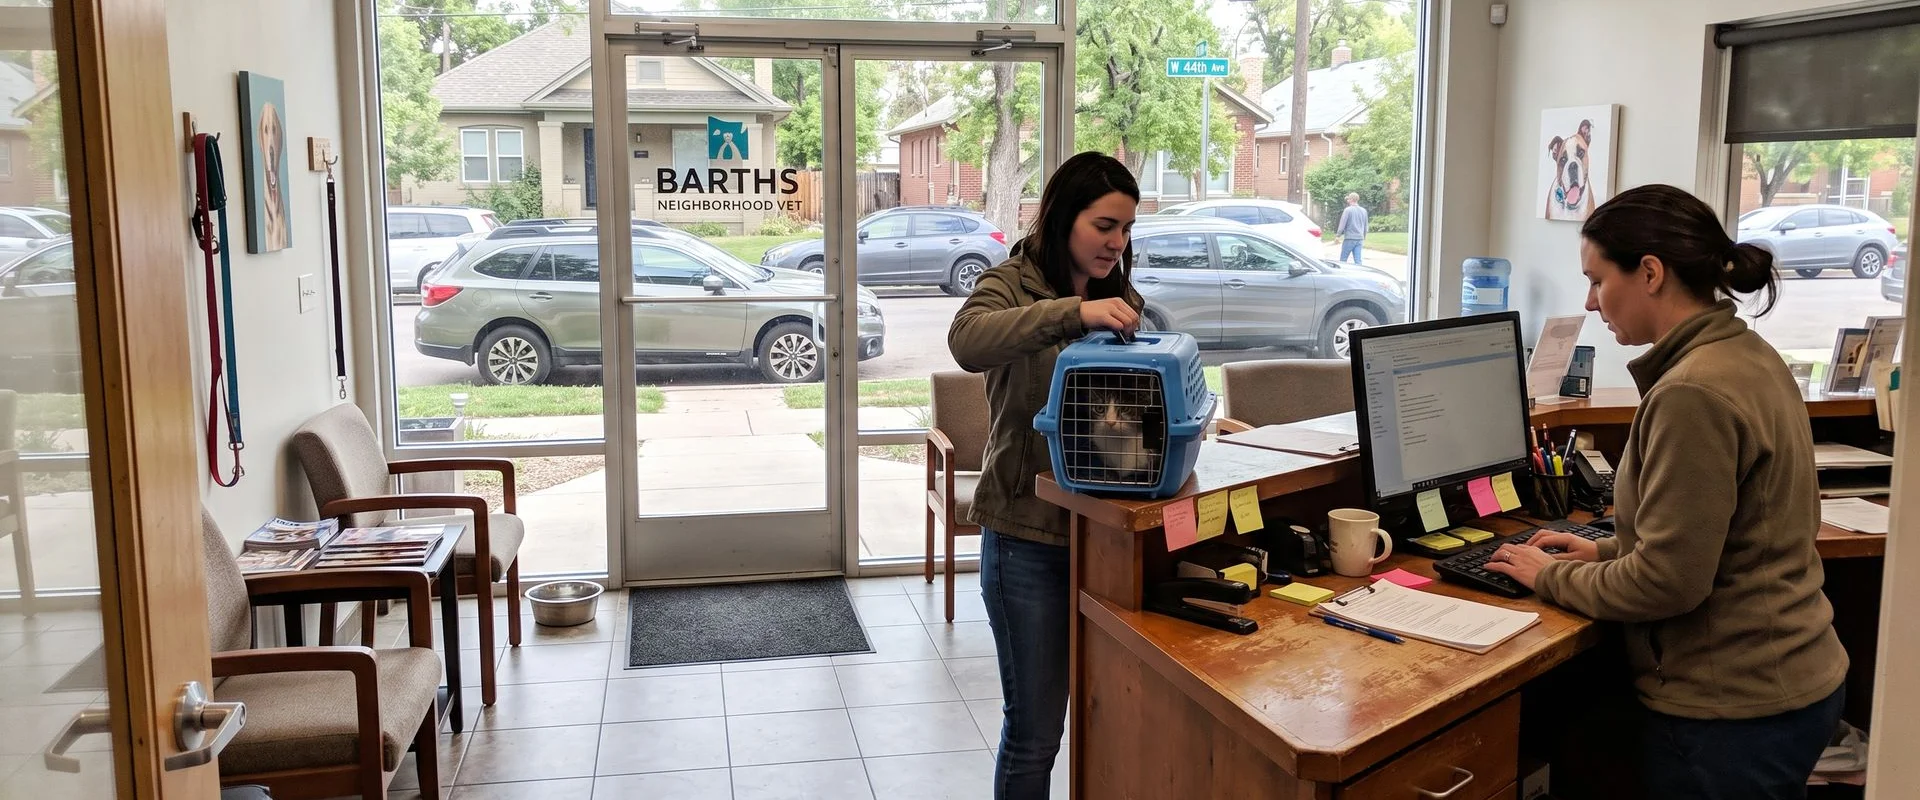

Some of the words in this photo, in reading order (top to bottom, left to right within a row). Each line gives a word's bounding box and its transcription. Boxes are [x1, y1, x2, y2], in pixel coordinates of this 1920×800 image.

[1170, 61, 1180, 73] W
[1183, 61, 1207, 73] 44th
[1211, 63, 1225, 72] Ave
[657, 168, 799, 194] BARTHS
[658, 200, 773, 210] NEIGHBORHOOD
[777, 200, 802, 210] VET
